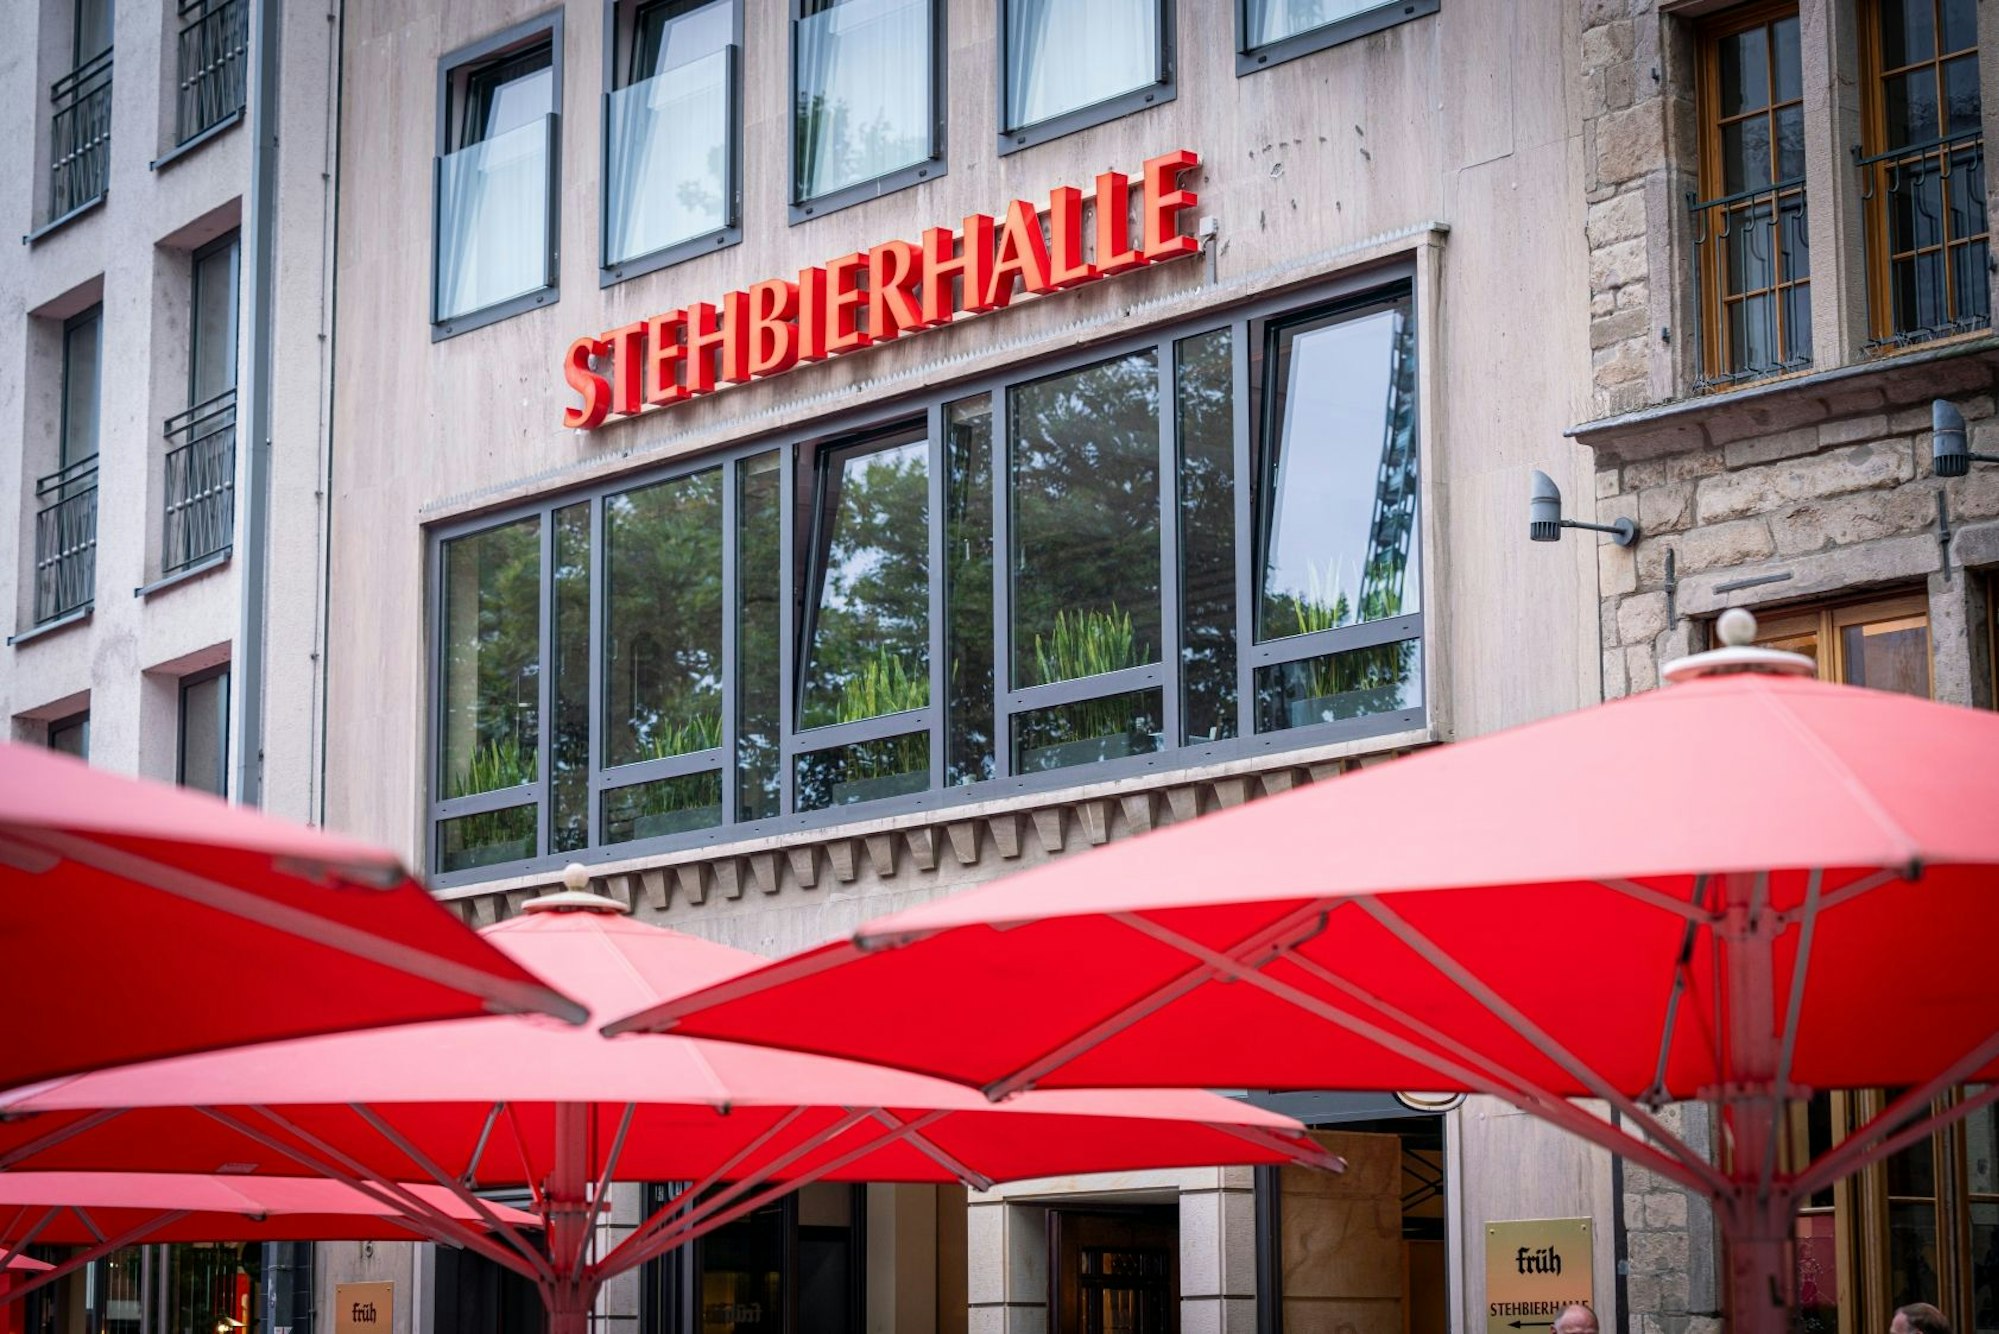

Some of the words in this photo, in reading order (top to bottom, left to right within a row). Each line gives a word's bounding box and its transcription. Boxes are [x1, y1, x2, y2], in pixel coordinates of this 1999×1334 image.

[563, 149, 1199, 429] STEHBIERHALLE
[1515, 1245, 1562, 1276] früh
[352, 1302, 377, 1323] früh
[1490, 1300, 1589, 1317] STEHBIERH
